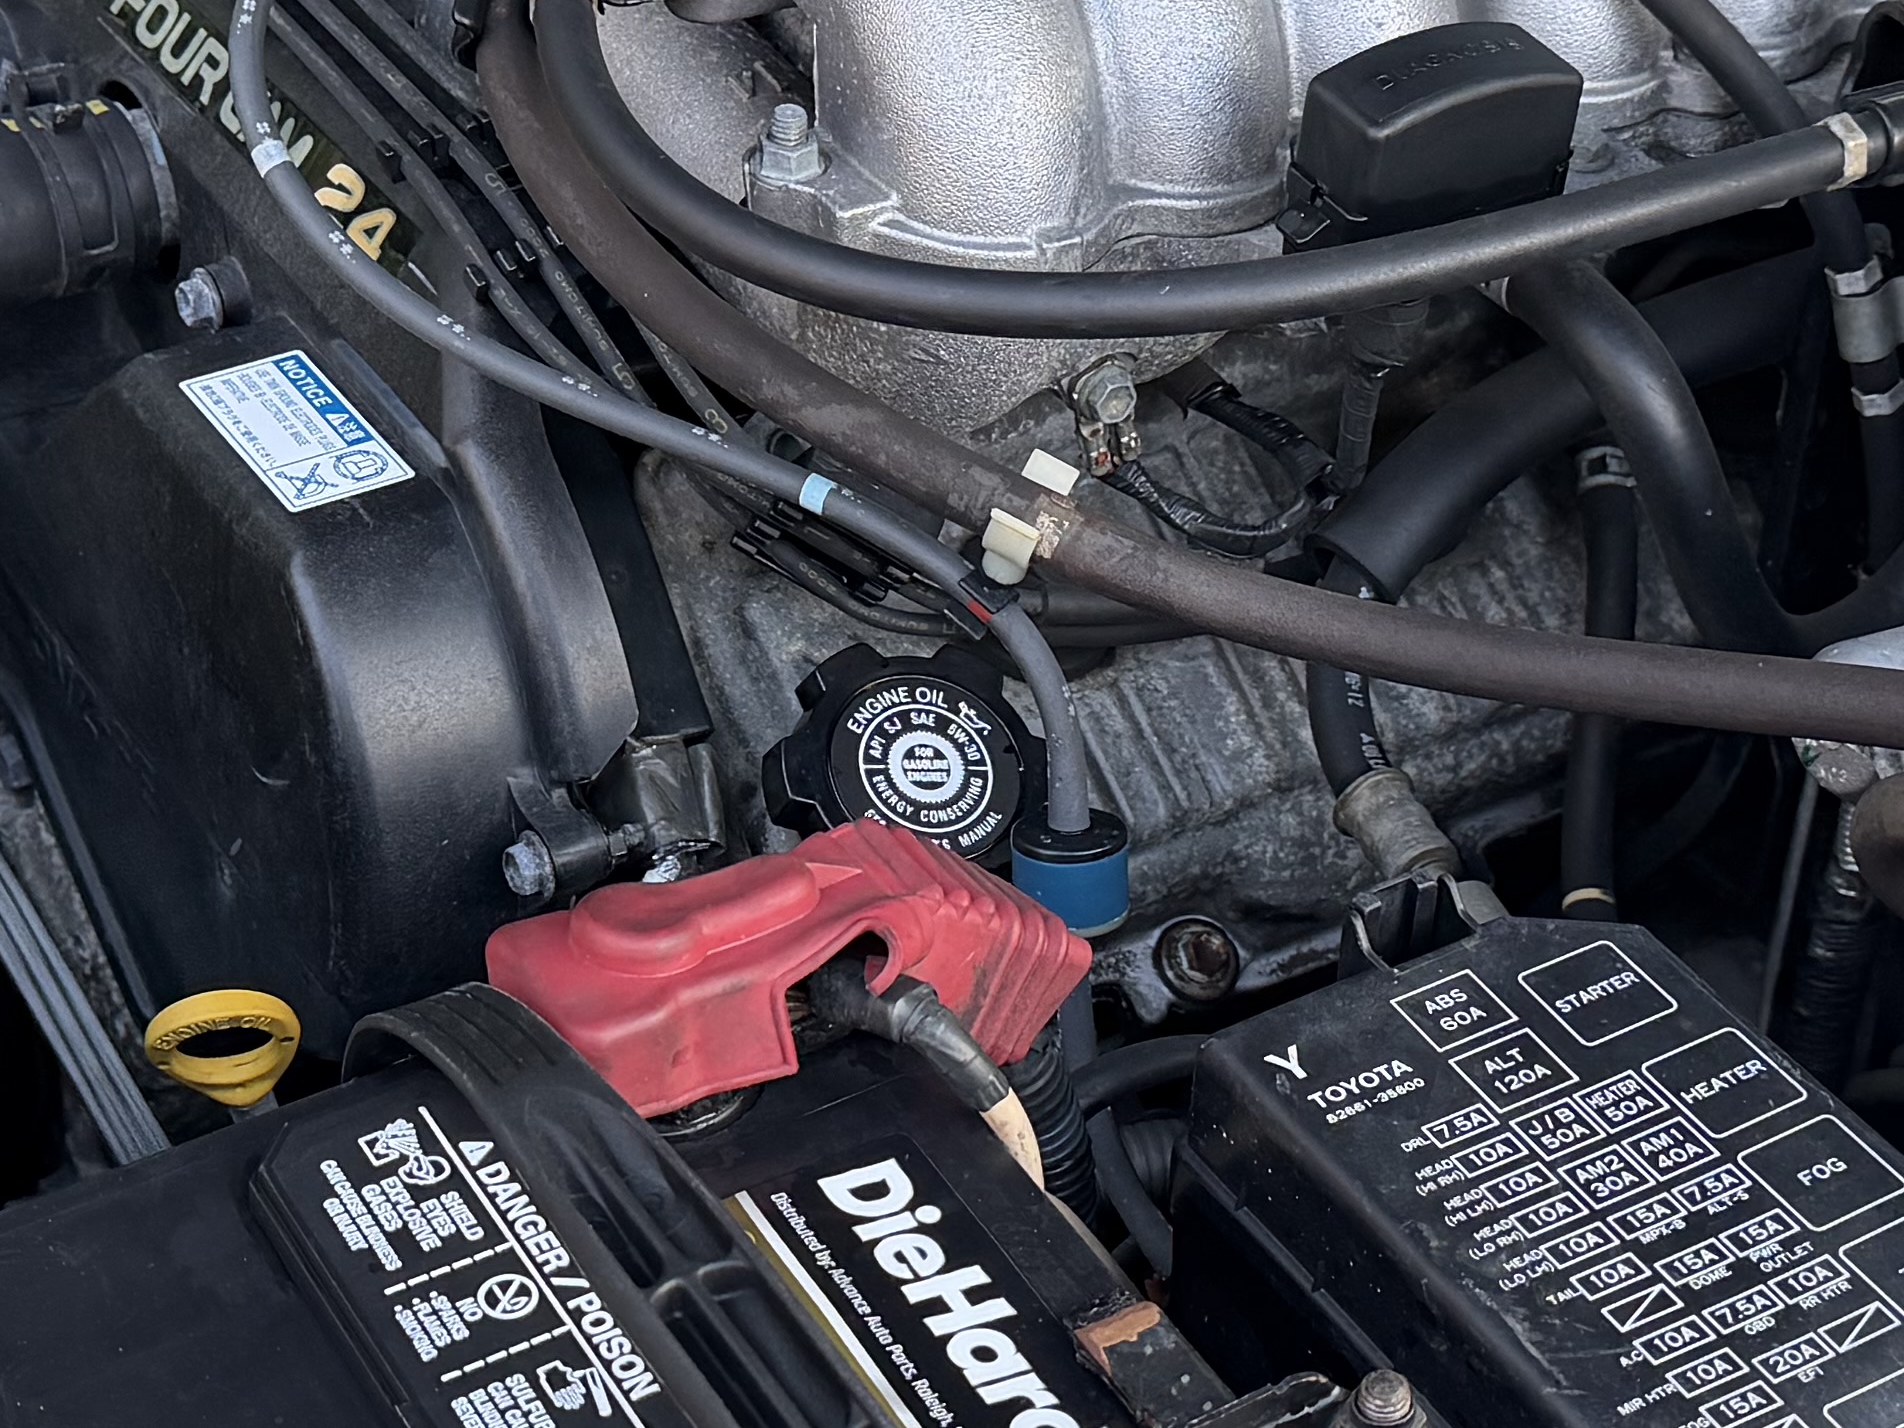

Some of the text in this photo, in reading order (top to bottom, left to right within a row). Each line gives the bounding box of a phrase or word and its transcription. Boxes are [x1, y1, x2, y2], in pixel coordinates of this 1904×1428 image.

[313, 162, 398, 264] 24
[278, 350, 333, 416] NOTICE
[846, 686, 948, 734] ENGINE OIL
[868, 735, 886, 758] API
[910, 711, 936, 726] SAE
[872, 774, 983, 822] ENERGY CONSERVING
[957, 811, 1002, 846] MANUAL
[1424, 988, 1468, 1014] ABS
[1554, 971, 1640, 1015] STARTER
[1439, 1006, 1487, 1031] 60A
[1264, 1044, 1308, 1080] Y
[1484, 1047, 1526, 1075] ALT
[1307, 1059, 1414, 1110] TOYOTA
[1495, 1063, 1552, 1095] 120A
[1680, 1053, 1768, 1105] HEATER
[1587, 1079, 1641, 1109] HEATER
[1604, 1095, 1654, 1123] 50A
[1433, 1112, 1488, 1139] 7.5A
[1540, 1123, 1591, 1150] 50A
[1400, 1137, 1431, 1153] DRL
[1469, 1140, 1514, 1167] 10A
[1638, 1127, 1684, 1156] AM1
[1658, 1140, 1703, 1170] 40A
[1415, 1159, 1453, 1181] HEAD
[1498, 1170, 1543, 1197] 10A
[1575, 1155, 1625, 1184] AM2
[1590, 1170, 1639, 1198] 30A
[1797, 1157, 1848, 1187] FOG
[1444, 1188, 1483, 1211] HEAD
[1684, 1171, 1740, 1202] 7.5A
[360, 1183, 403, 1232] GASES
[379, 1175, 443, 1252] EXPLOSIVE
[419, 1198, 457, 1237] EYES
[439, 1190, 485, 1241] SHIELD
[1529, 1201, 1574, 1227] 10A
[1626, 1200, 1672, 1228] 15A
[1473, 1218, 1513, 1242] HEAD
[1558, 1231, 1604, 1258] 10A
[1738, 1215, 1785, 1245] 15A
[1502, 1249, 1543, 1272] HEAD
[1673, 1245, 1720, 1274] 15A
[1759, 1241, 1815, 1272] OUTLET
[475, 1161, 571, 1274] DANGER
[566, 1291, 661, 1402] POISON
[1590, 1262, 1636, 1289] 10A
[1688, 1266, 1733, 1291] DOME
[1787, 1265, 1834, 1292] 10A
[455, 1296, 484, 1322] NO
[770, 1192, 827, 1252] Distributed
[827, 1268, 872, 1315] Advance
[863, 1315, 893, 1345] Auto
[885, 1343, 918, 1381] Parts,
[910, 1378, 954, 1428] Raleigh,
[1546, 1288, 1581, 1306] TAIL
[1714, 1292, 1773, 1324] 7.5A
[1798, 1280, 1853, 1311] RR HTR
[1653, 1325, 1700, 1353] 10A
[1685, 1357, 1733, 1385] 10A
[1768, 1343, 1820, 1373] 20A
[1797, 1366, 1824, 1384] EFI
[486, 1381, 515, 1410] CAN
[1616, 1382, 1677, 1417] MIR HTR
[1717, 1390, 1768, 1421] 15A
